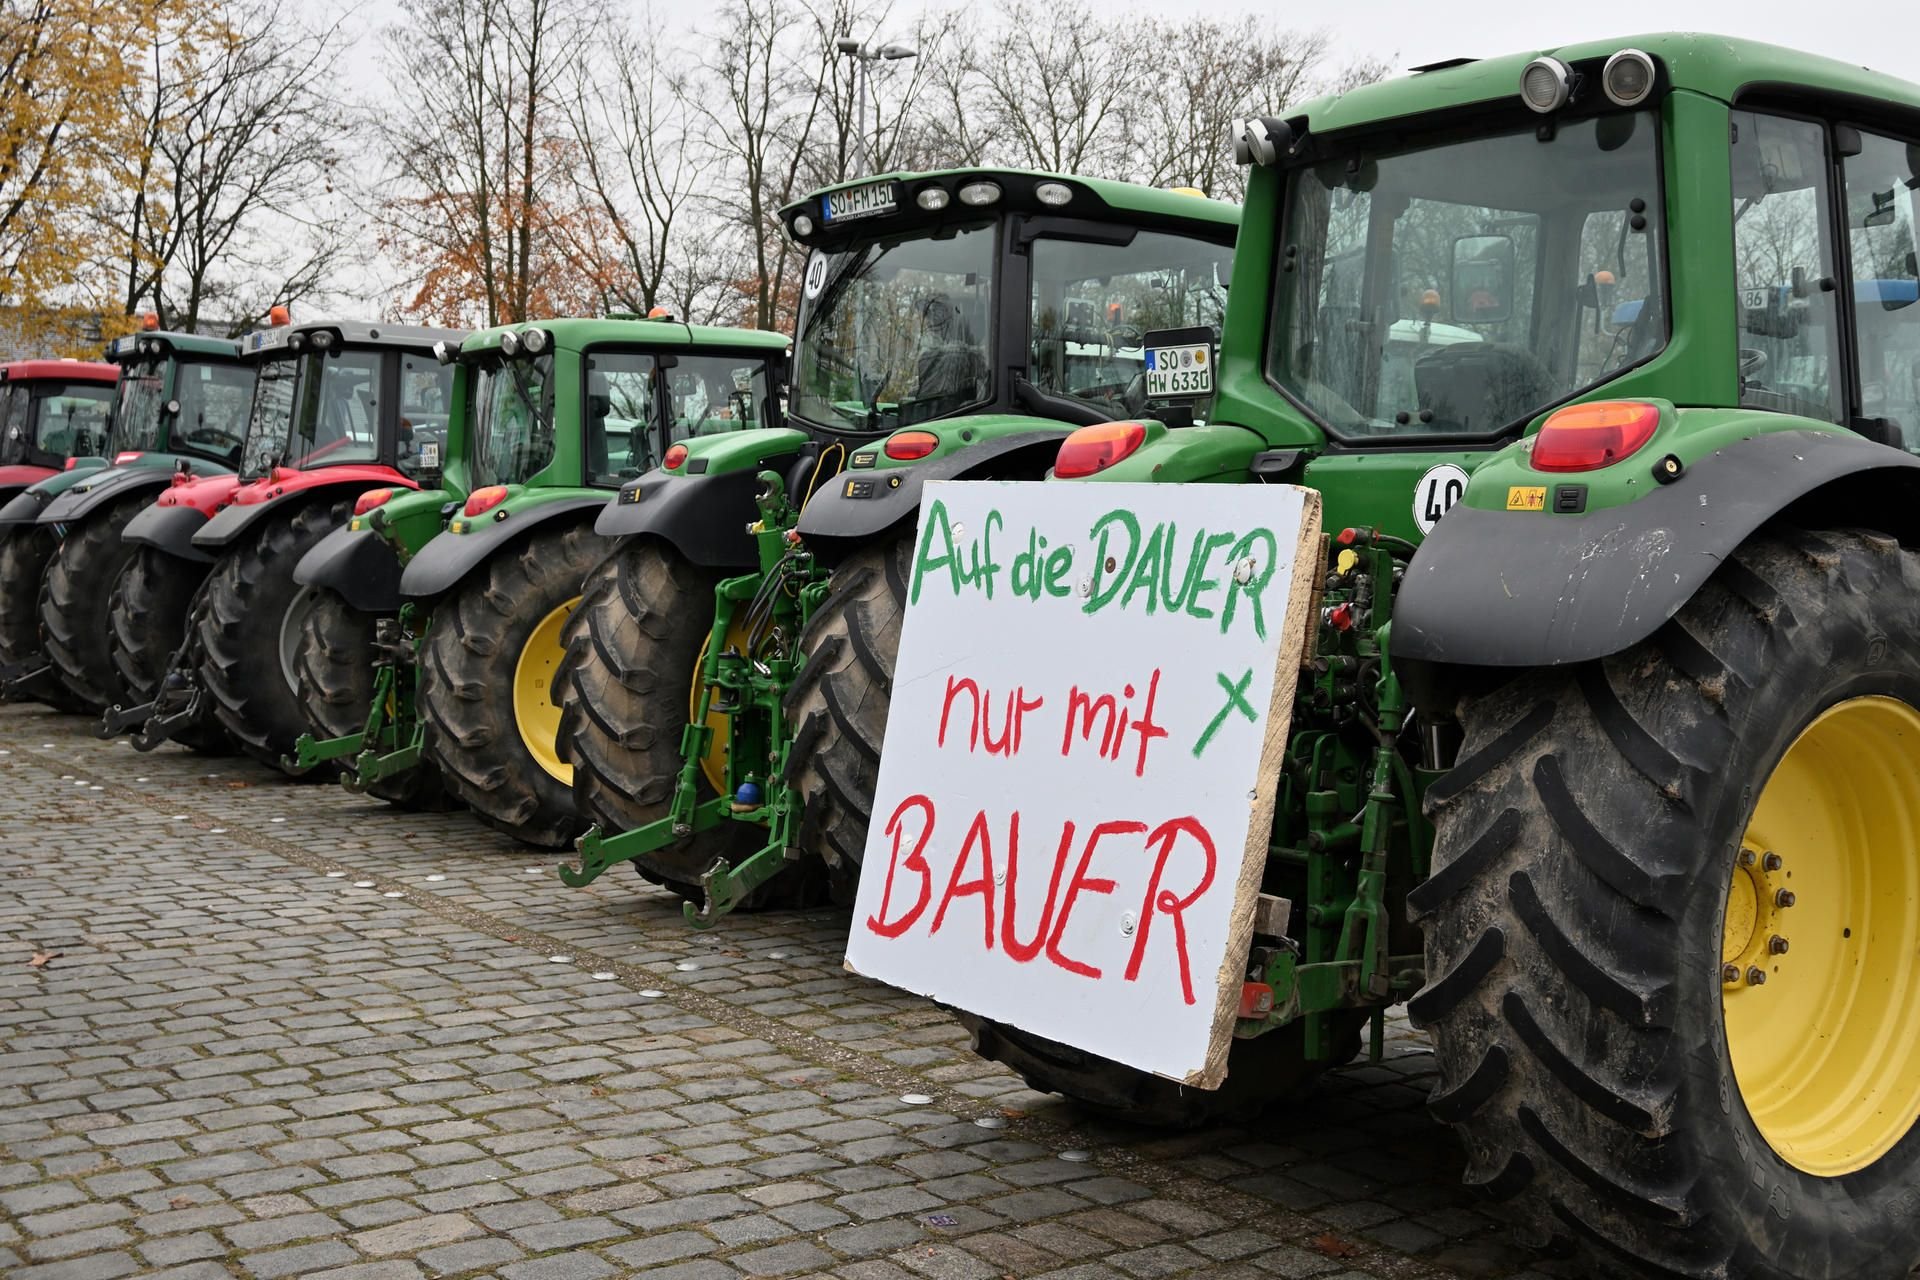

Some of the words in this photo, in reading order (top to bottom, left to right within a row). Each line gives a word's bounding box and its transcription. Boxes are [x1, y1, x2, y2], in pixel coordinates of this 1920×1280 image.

[830, 191, 846, 216] SO
[853, 188, 870, 209] FM
[808, 260, 823, 290] 40
[1159, 351, 1178, 370] SO
[1148, 373, 1166, 393] HW
[1171, 368, 1209, 391] 6330
[1424, 478, 1463, 525] 40
[911, 499, 1002, 605] Auf
[1011, 526, 1074, 601] die
[1082, 508, 1277, 640] DAUER
[937, 673, 1043, 757] nur
[1061, 668, 1168, 777] mit
[867, 793, 1217, 1006] BAUER
